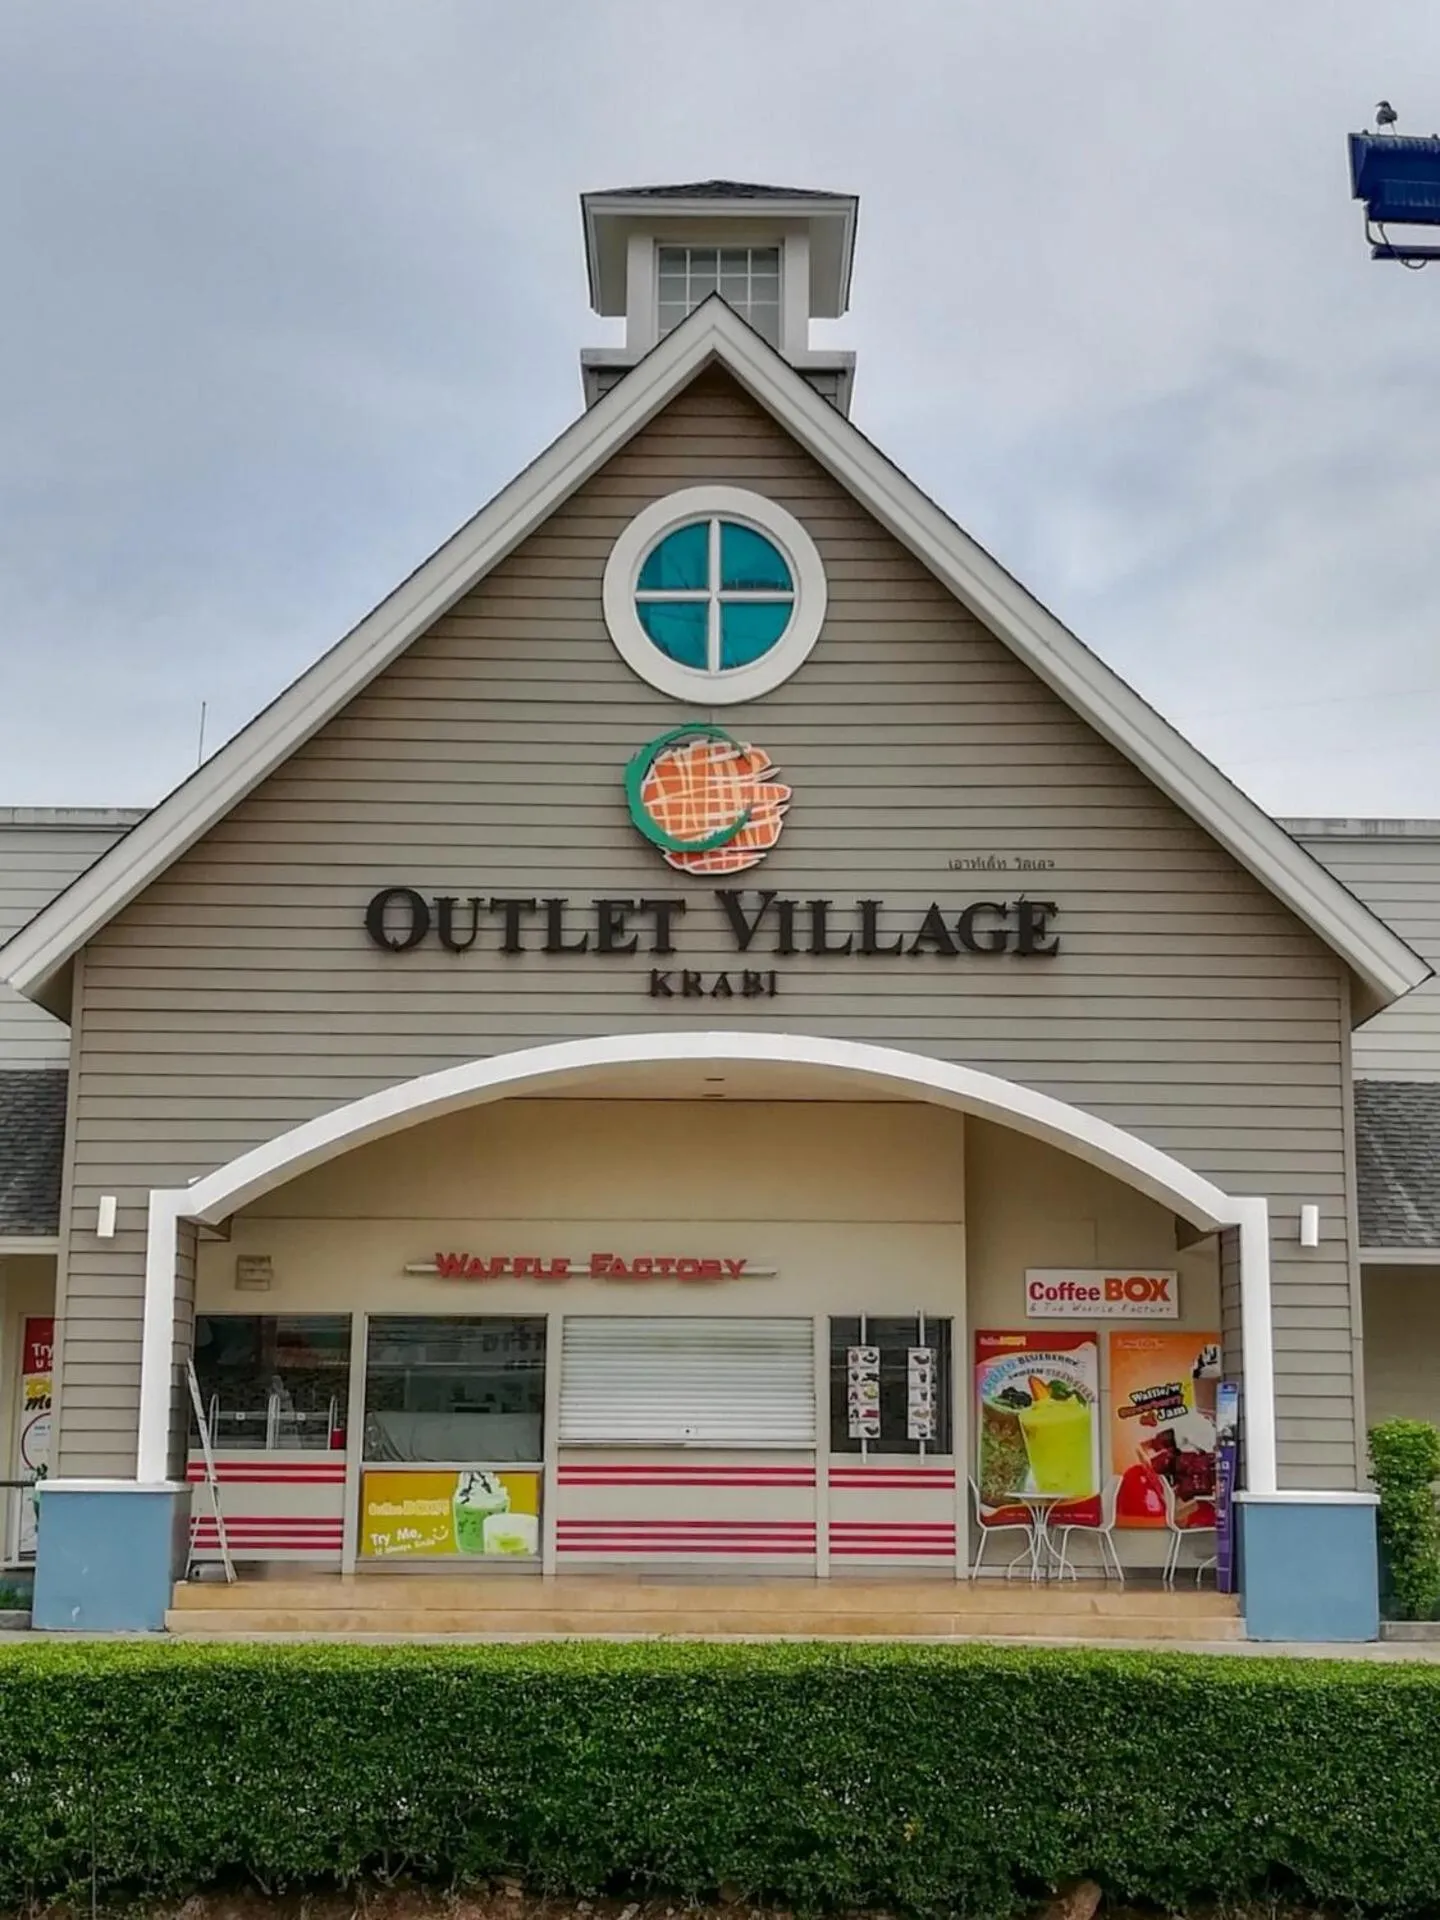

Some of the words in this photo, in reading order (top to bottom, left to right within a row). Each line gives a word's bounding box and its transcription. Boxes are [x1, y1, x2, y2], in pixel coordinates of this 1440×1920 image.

[364, 887, 686, 953] OUTLET
[714, 889, 1061, 959] VILLAGE
[649, 968, 780, 998] KRABI
[1029, 1281, 1100, 1301] Coffee
[1104, 1277, 1172, 1302] BOX
[1158, 1407, 1186, 1420] Jam
[370, 1532, 391, 1547] Try
